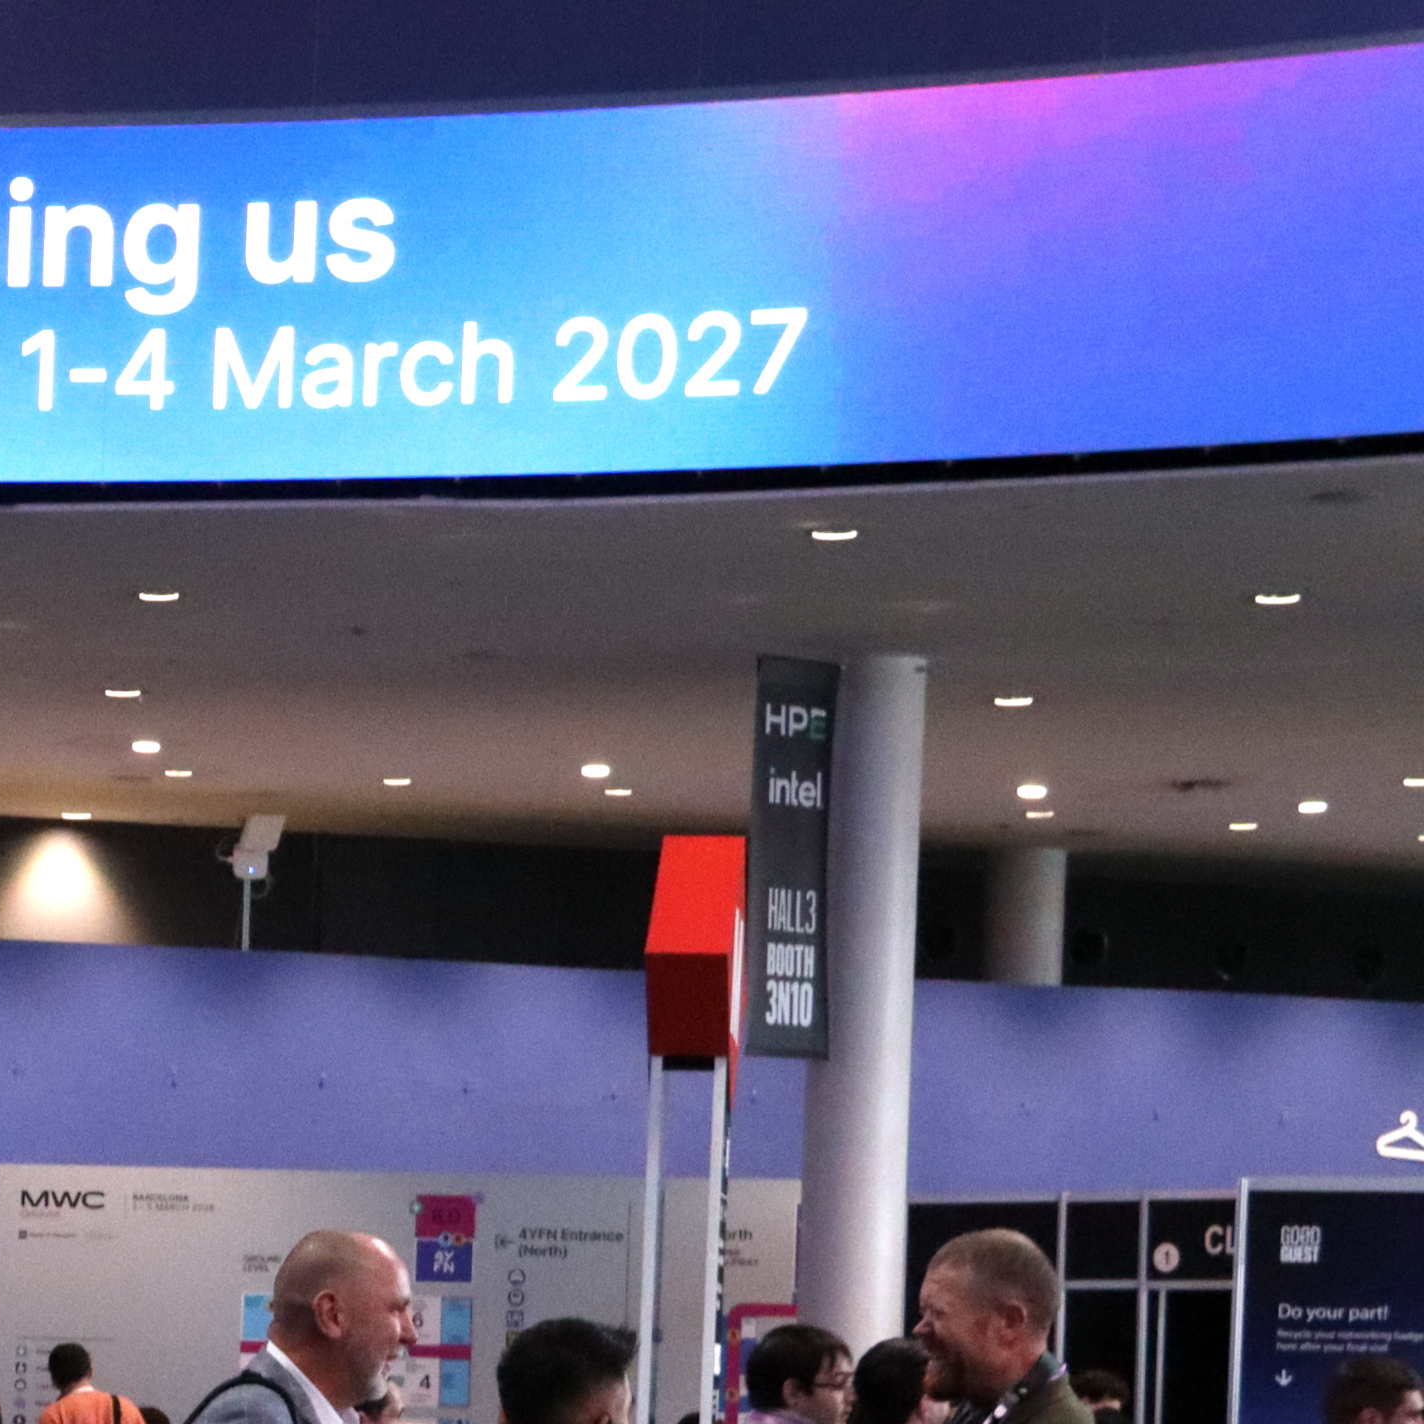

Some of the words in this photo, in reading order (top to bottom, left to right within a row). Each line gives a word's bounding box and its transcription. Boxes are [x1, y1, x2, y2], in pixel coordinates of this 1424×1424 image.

[244, 196, 397, 284] us
[212, 320, 514, 410] March
[553, 306, 808, 402] 2027
[765, 703, 827, 742] HPE
[768, 767, 824, 809] intel
[767, 942, 814, 978] BOOTH
[765, 980, 813, 1028] 3N10
[21, 1190, 105, 1209] MWC
[561, 1228, 624, 1242] Entrance
[1279, 1246, 1321, 1264] GUEST
[1278, 1303, 1303, 1320] Do
[1306, 1306, 1345, 1323] your
[1348, 1304, 1390, 1324] part!
